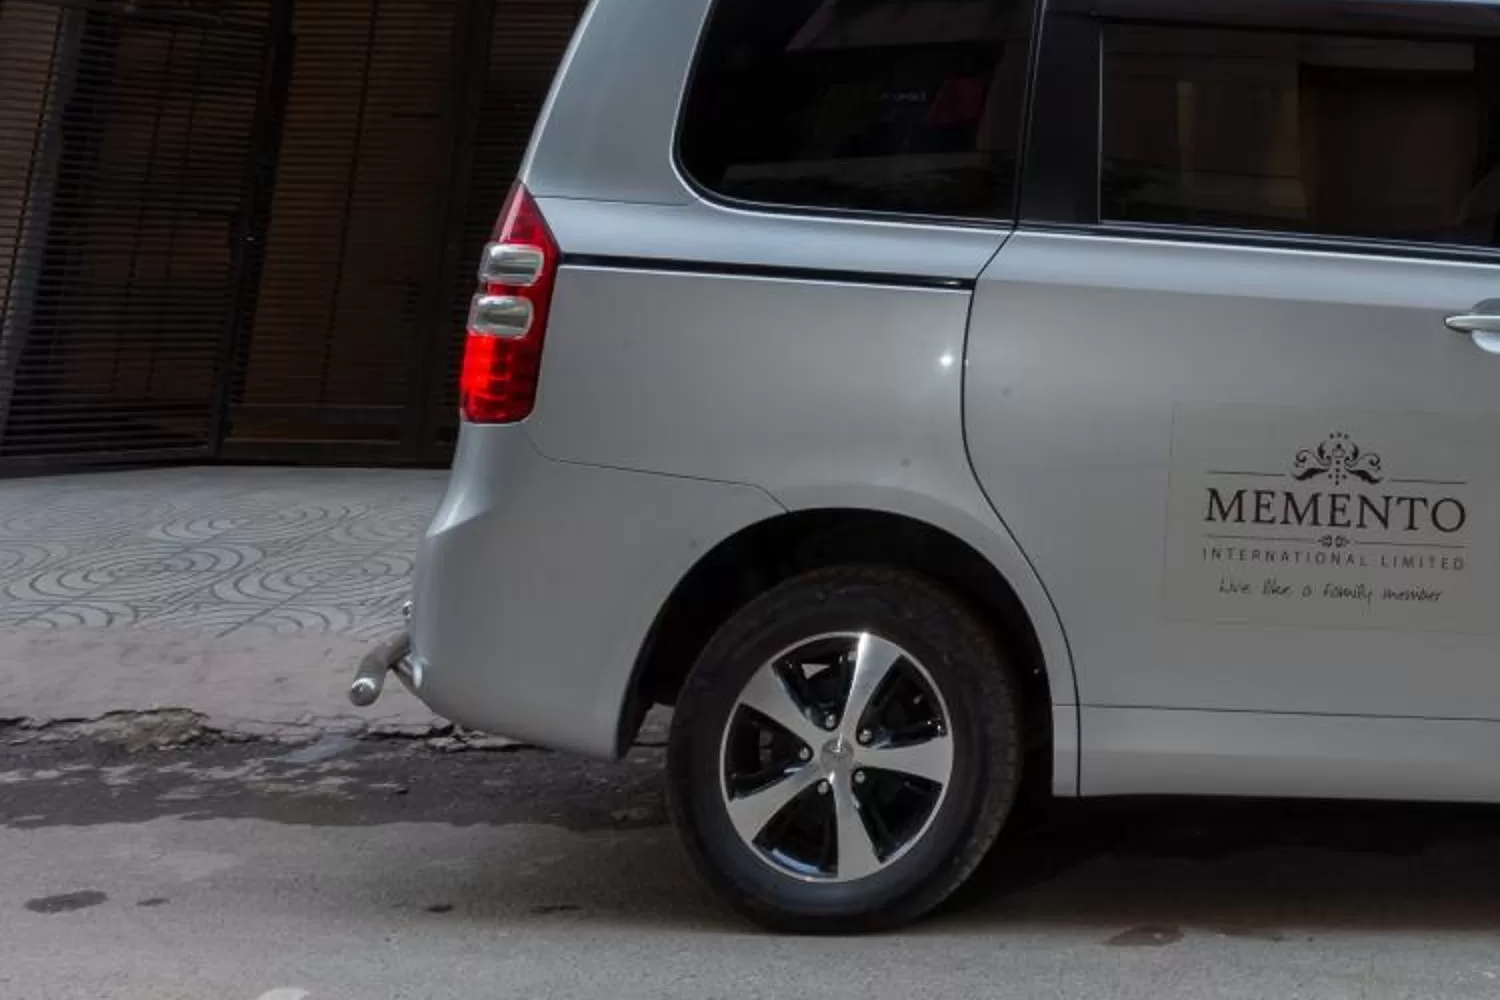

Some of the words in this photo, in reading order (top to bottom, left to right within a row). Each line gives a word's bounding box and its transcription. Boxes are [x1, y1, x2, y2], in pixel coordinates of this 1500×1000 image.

[1204, 487, 1467, 533] MEMENTO
[1203, 547, 1369, 567] INTERNATIONAL
[1380, 554, 1465, 571] LIMITED
